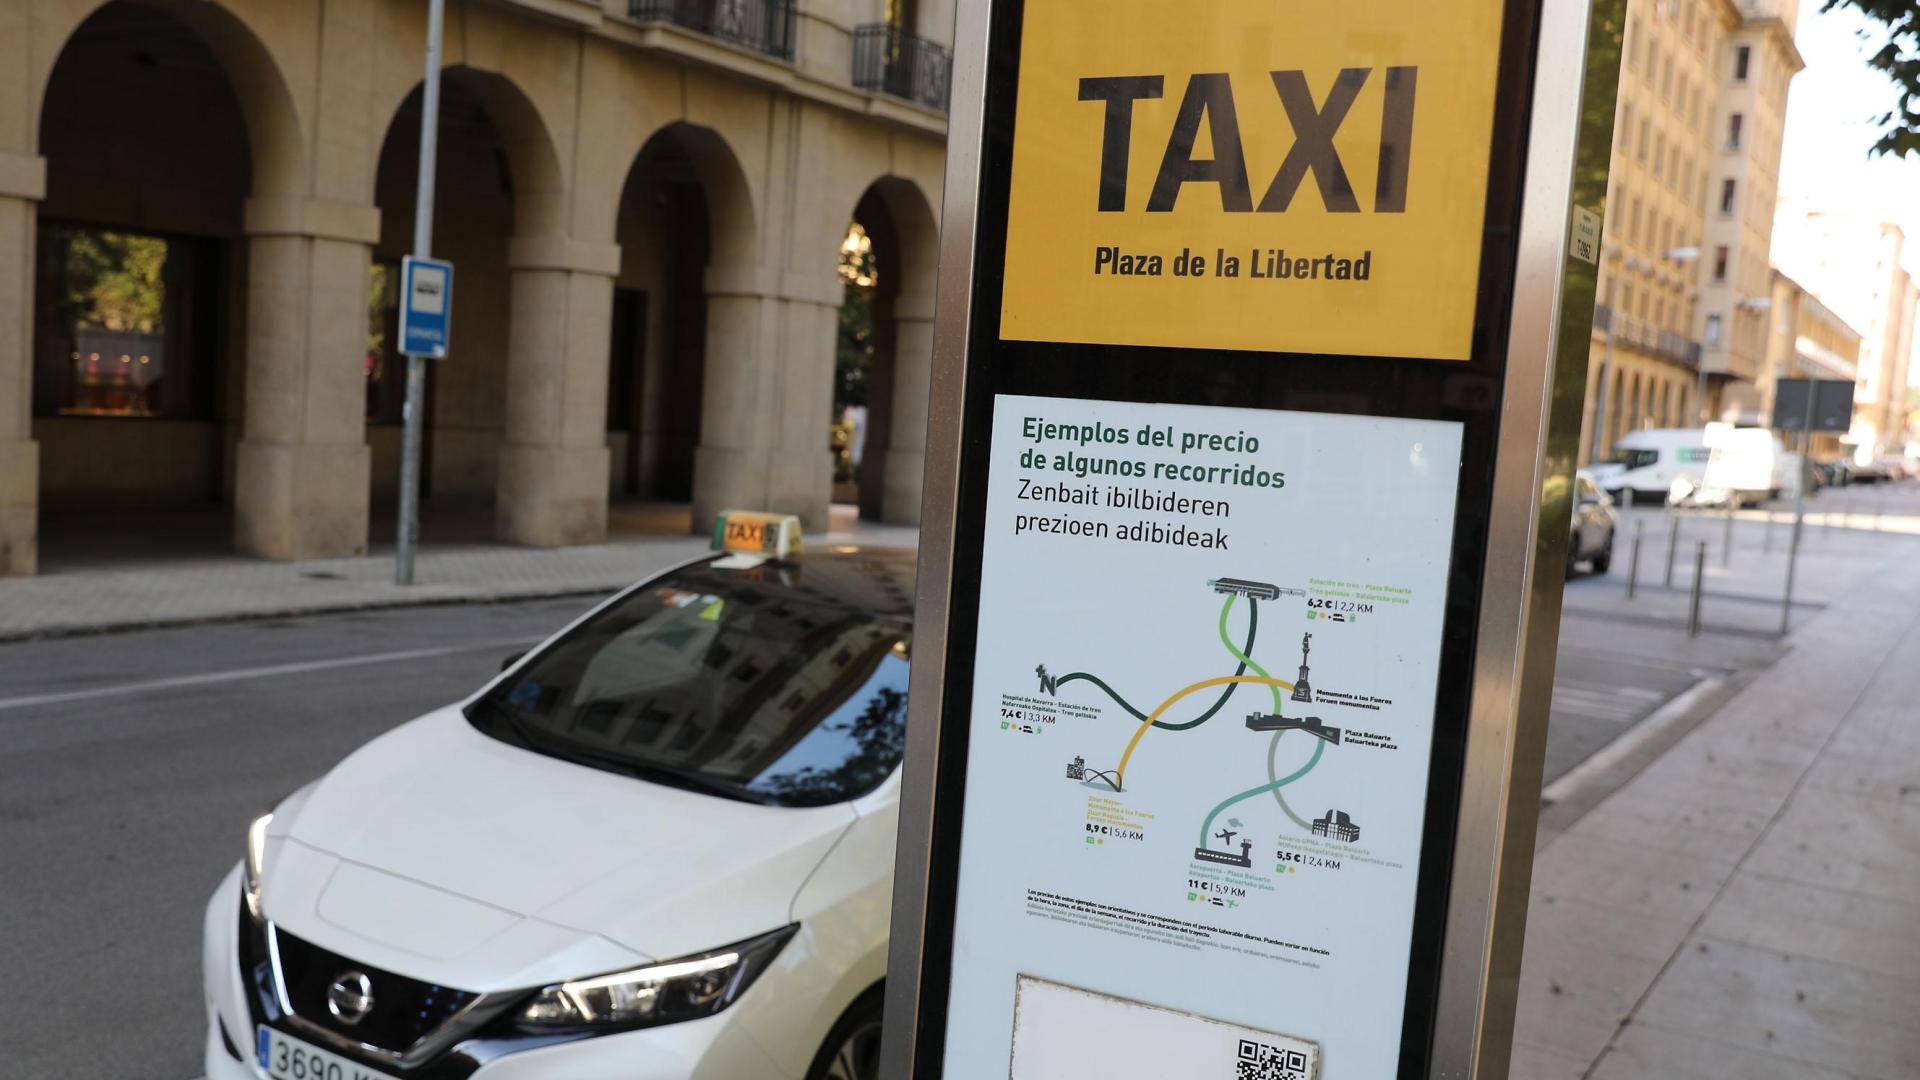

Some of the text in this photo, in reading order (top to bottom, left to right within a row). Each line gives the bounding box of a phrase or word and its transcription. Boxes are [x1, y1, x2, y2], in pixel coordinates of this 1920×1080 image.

[1078, 66, 1418, 213] TAXI
[1095, 247, 1371, 280] Plaza de la Libertad
[1023, 417, 1259, 454] Ejemplos del precio
[1020, 449, 1285, 489] de algunos recorridos
[1017, 479, 1230, 517] Zenbait ibilbideren
[728, 522, 764, 542] TAXI
[1016, 514, 1228, 550] prezioen adibideak
[1308, 598, 1322, 608] 6,2
[1325, 600, 1332, 608] €
[1341, 602, 1355, 612] 2,2
[1357, 604, 1373, 613] KM
[1003, 694, 1023, 702] Hospital
[1033, 698, 1053, 706] Navarra
[1059, 702, 1080, 710] Estación
[1316, 697, 1380, 710] Foruen monumentua
[1317, 689, 1352, 699] Monumento
[1370, 696, 1392, 704] Fueros
[1002, 709, 1014, 718] 7,4
[1029, 713, 1040, 722] 3,3
[1042, 715, 1056, 724] KM
[1364, 732, 1391, 741] Baluarte
[1086, 824, 1099, 833] 8,9
[1101, 826, 1108, 834] €
[1115, 829, 1127, 838] 5,6
[1130, 832, 1143, 841] KM
[1277, 851, 1291, 861] 5,5
[1294, 854, 1301, 862] €
[1310, 856, 1321, 867] 2,4
[1325, 860, 1340, 870] KM
[1189, 880, 1198, 888] 11
[1201, 882, 1208, 890] €
[1216, 885, 1228, 894] 5,9
[1231, 888, 1246, 897] KM
